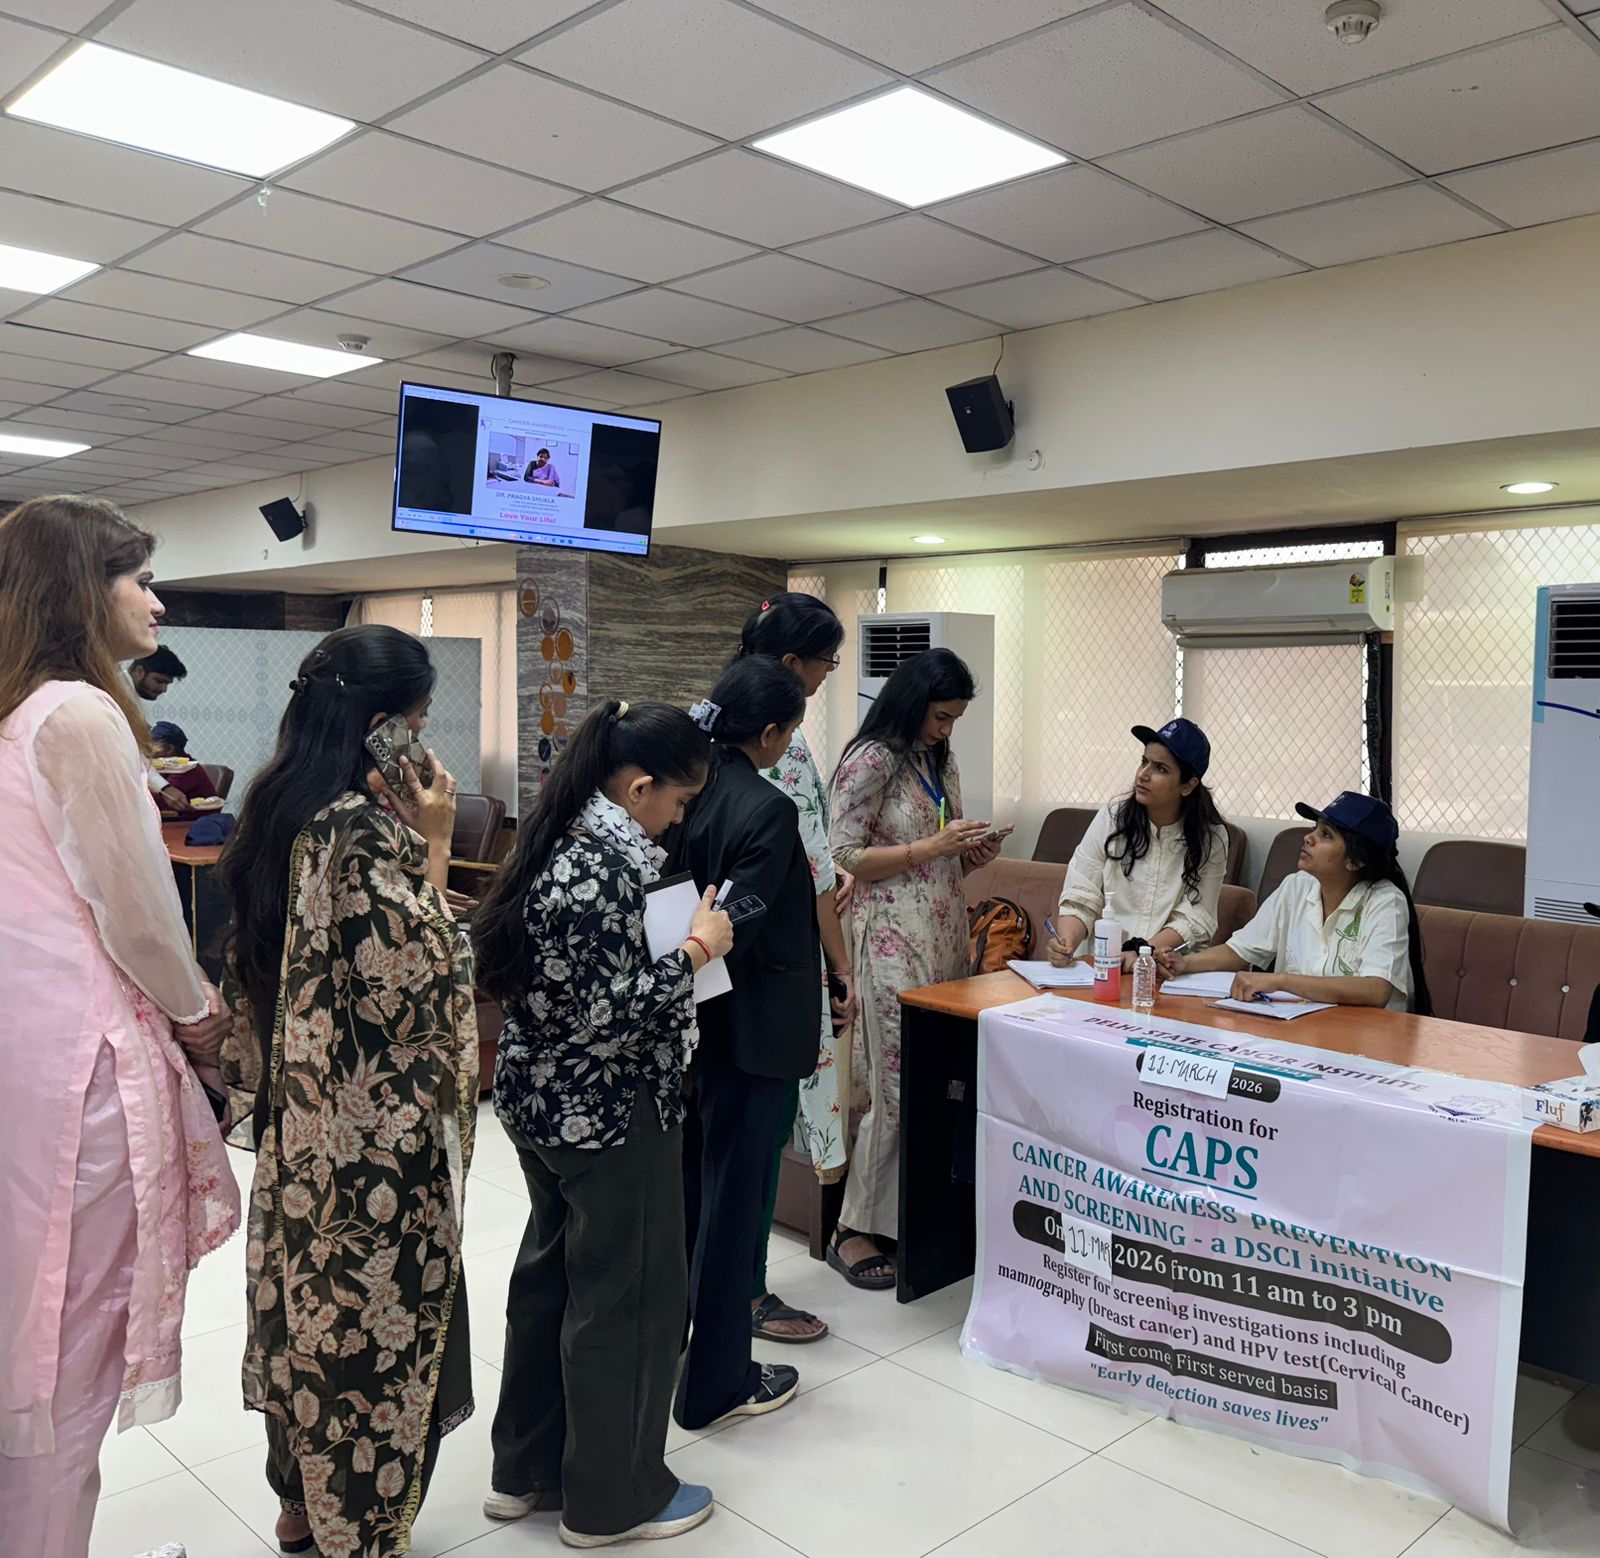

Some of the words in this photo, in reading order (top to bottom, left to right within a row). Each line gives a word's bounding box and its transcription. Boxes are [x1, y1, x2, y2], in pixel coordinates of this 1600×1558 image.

[500, 512, 519, 520] Love
[520, 514, 538, 522] Your
[540, 515, 557, 524] Life!
[1082, 1017, 1143, 1032] DELHI
[1142, 1029, 1206, 1046] STATE
[1208, 1043, 1298, 1065] CANCER
[1302, 1062, 1430, 1093] INSTITUTE
[1231, 1077, 1263, 1094] 2026
[1133, 1091, 1243, 1133] Registration
[1249, 1119, 1279, 1141] for
[1535, 1099, 1565, 1122] Fluf
[1145, 1124, 1259, 1190] CAPS
[1012, 1141, 1087, 1182] CANCER
[1092, 1167, 1237, 1223] AWARENESS
[1250, 1213, 1453, 1283] PREVENTION
[1018, 1174, 1061, 1202] AND
[1064, 1190, 1186, 1246] SCREENING
[1211, 1237, 1226, 1254] a
[1235, 1236, 1301, 1269] DSCI
[1310, 1254, 1445, 1313] initiative
[1043, 1253, 1090, 1287] Register
[1093, 1274, 1111, 1296] for
[1193, 1303, 1318, 1345] investigations
[1324, 1331, 1406, 1380] including
[1114, 1243, 1167, 1273] 2026
[1171, 1259, 1225, 1290] from
[1231, 1272, 1261, 1297] 11
[1267, 1284, 1305, 1307] am
[1311, 1289, 1337, 1311] to
[1343, 1296, 1358, 1318] 3
[1365, 1304, 1403, 1336] pm
[1088, 1296, 1135, 1328] (breast
[1203, 1332, 1236, 1352] and
[1240, 1339, 1278, 1361] HPV
[1283, 1350, 1397, 1396] test(Cervical
[1401, 1386, 1470, 1436] Cancer)
[1090, 1362, 1142, 1387] "Early
[1146, 1373, 1218, 1409] detection
[1222, 1402, 1271, 1422] saves
[1275, 1409, 1329, 1431] lives"
[1093, 1330, 1125, 1356] First
[1129, 1345, 1171, 1366] come
[1176, 1353, 1215, 1377] First
[1218, 1366, 1276, 1393] served
[1282, 1379, 1329, 1400] basis
